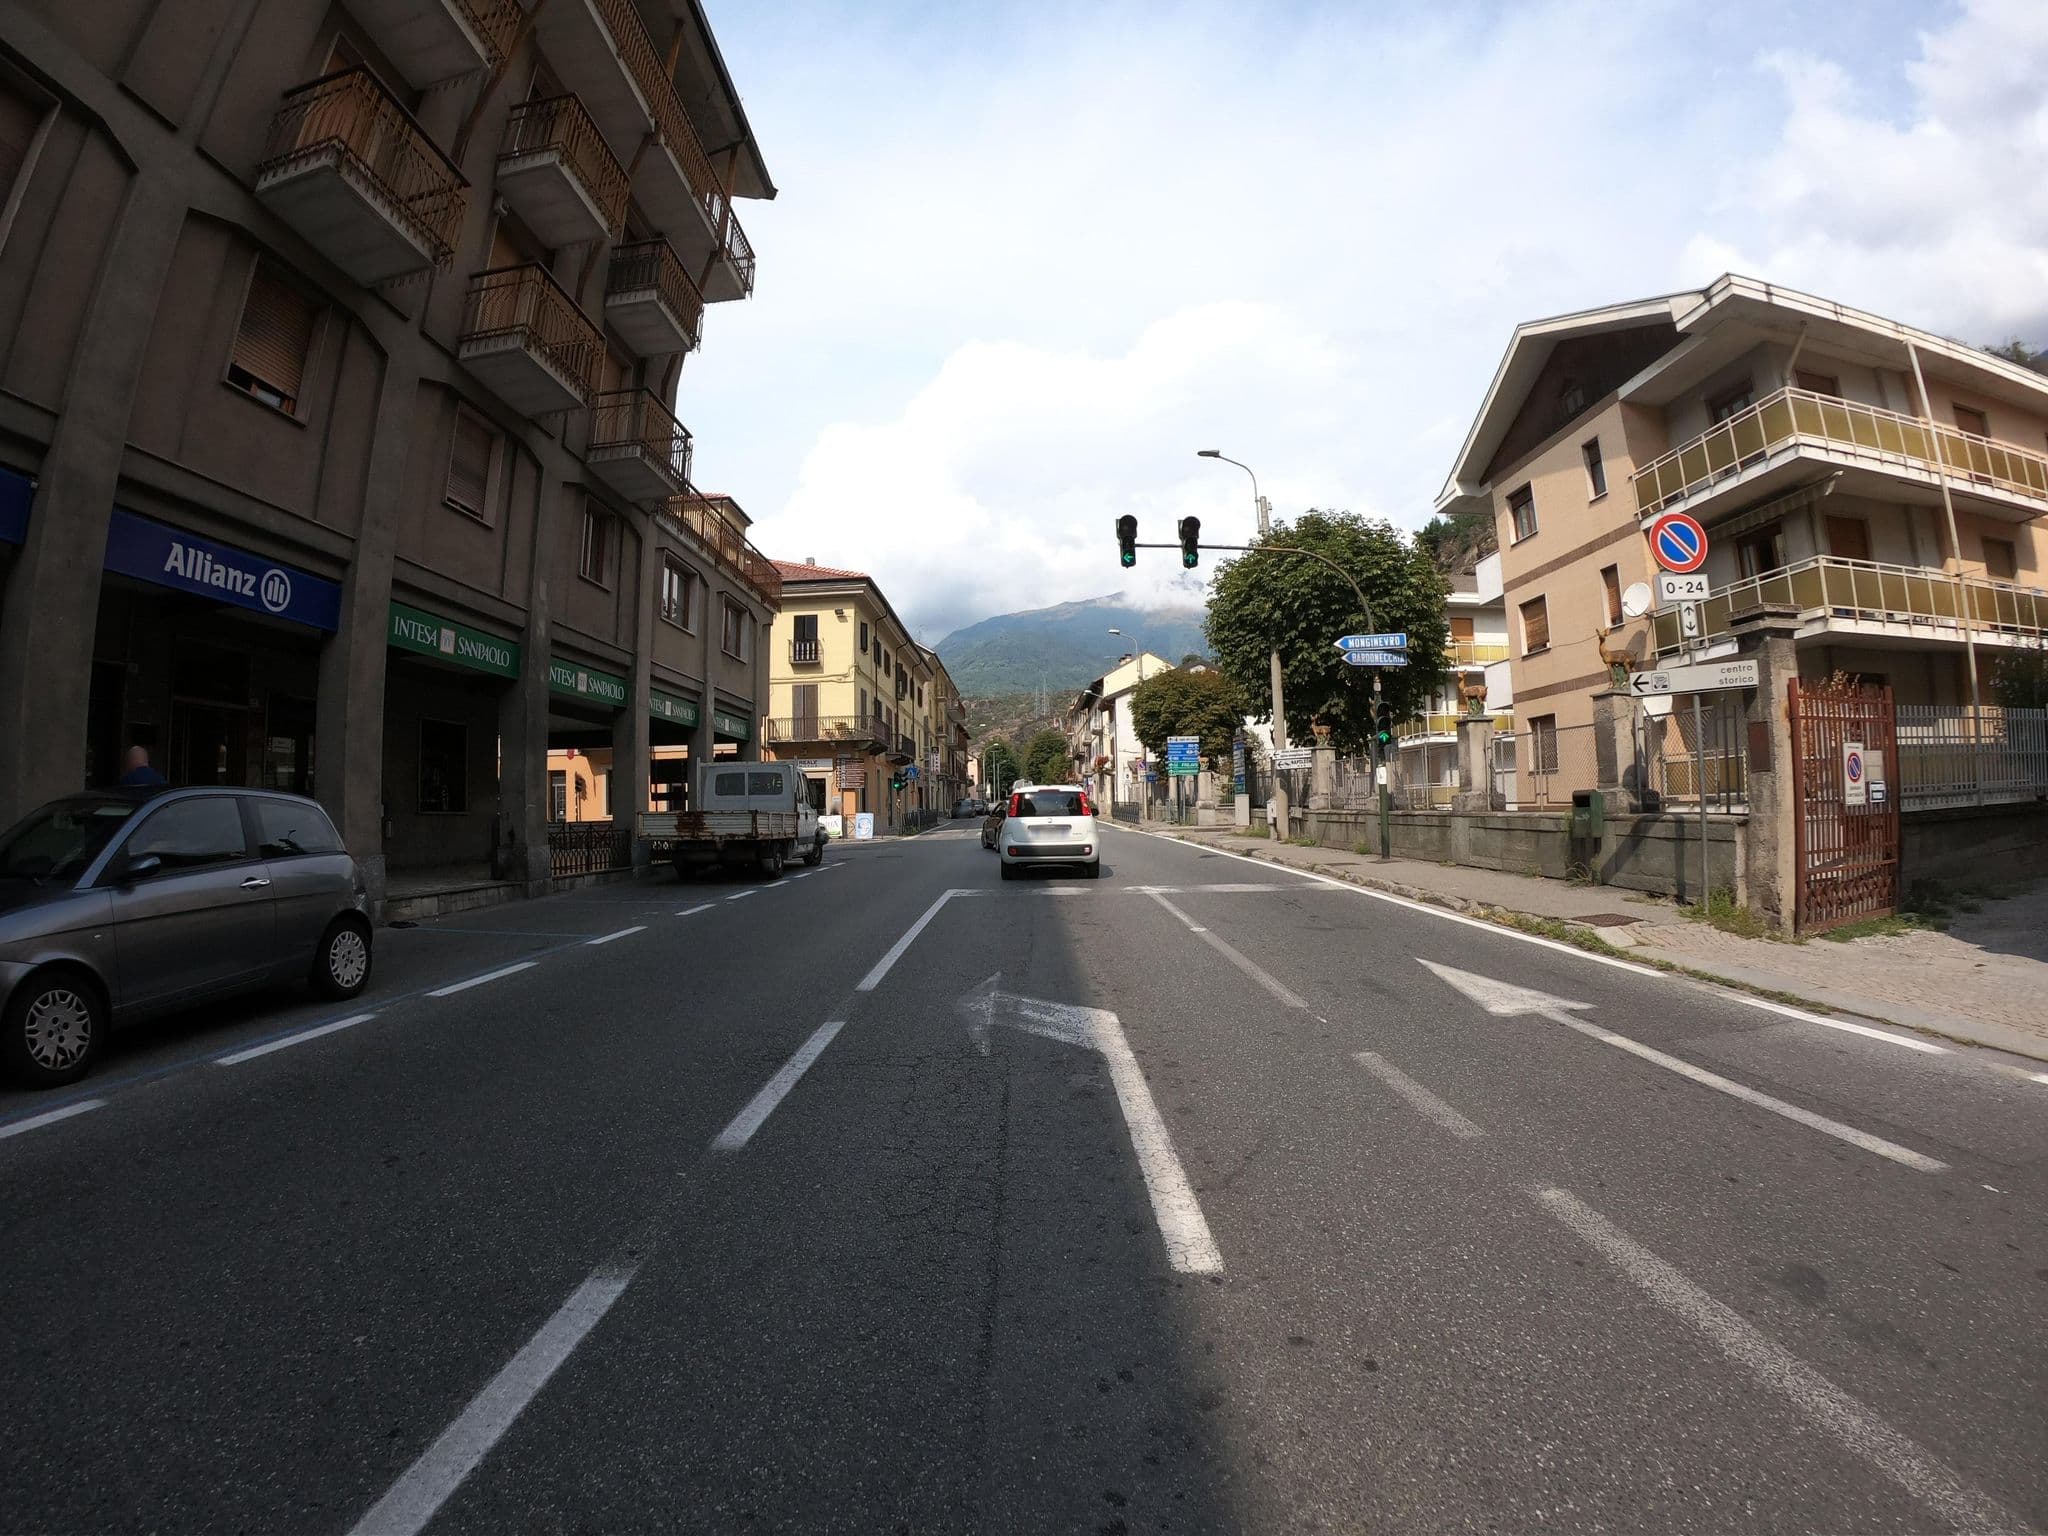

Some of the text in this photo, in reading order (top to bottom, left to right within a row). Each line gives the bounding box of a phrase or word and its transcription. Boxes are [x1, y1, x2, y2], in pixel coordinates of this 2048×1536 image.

[164, 542, 257, 597] Allianz
[394, 615, 510, 667] INTESA SANPAOLO
[1348, 636, 1400, 648] MONGINEVRO
[1352, 652, 1405, 663] BARDONECCHIA
[1720, 664, 1753, 674] centro
[549, 665, 625, 700] NTESA SANPAOLO
[1718, 675, 1754, 685] storico
[649, 697, 665, 713] NTESA
